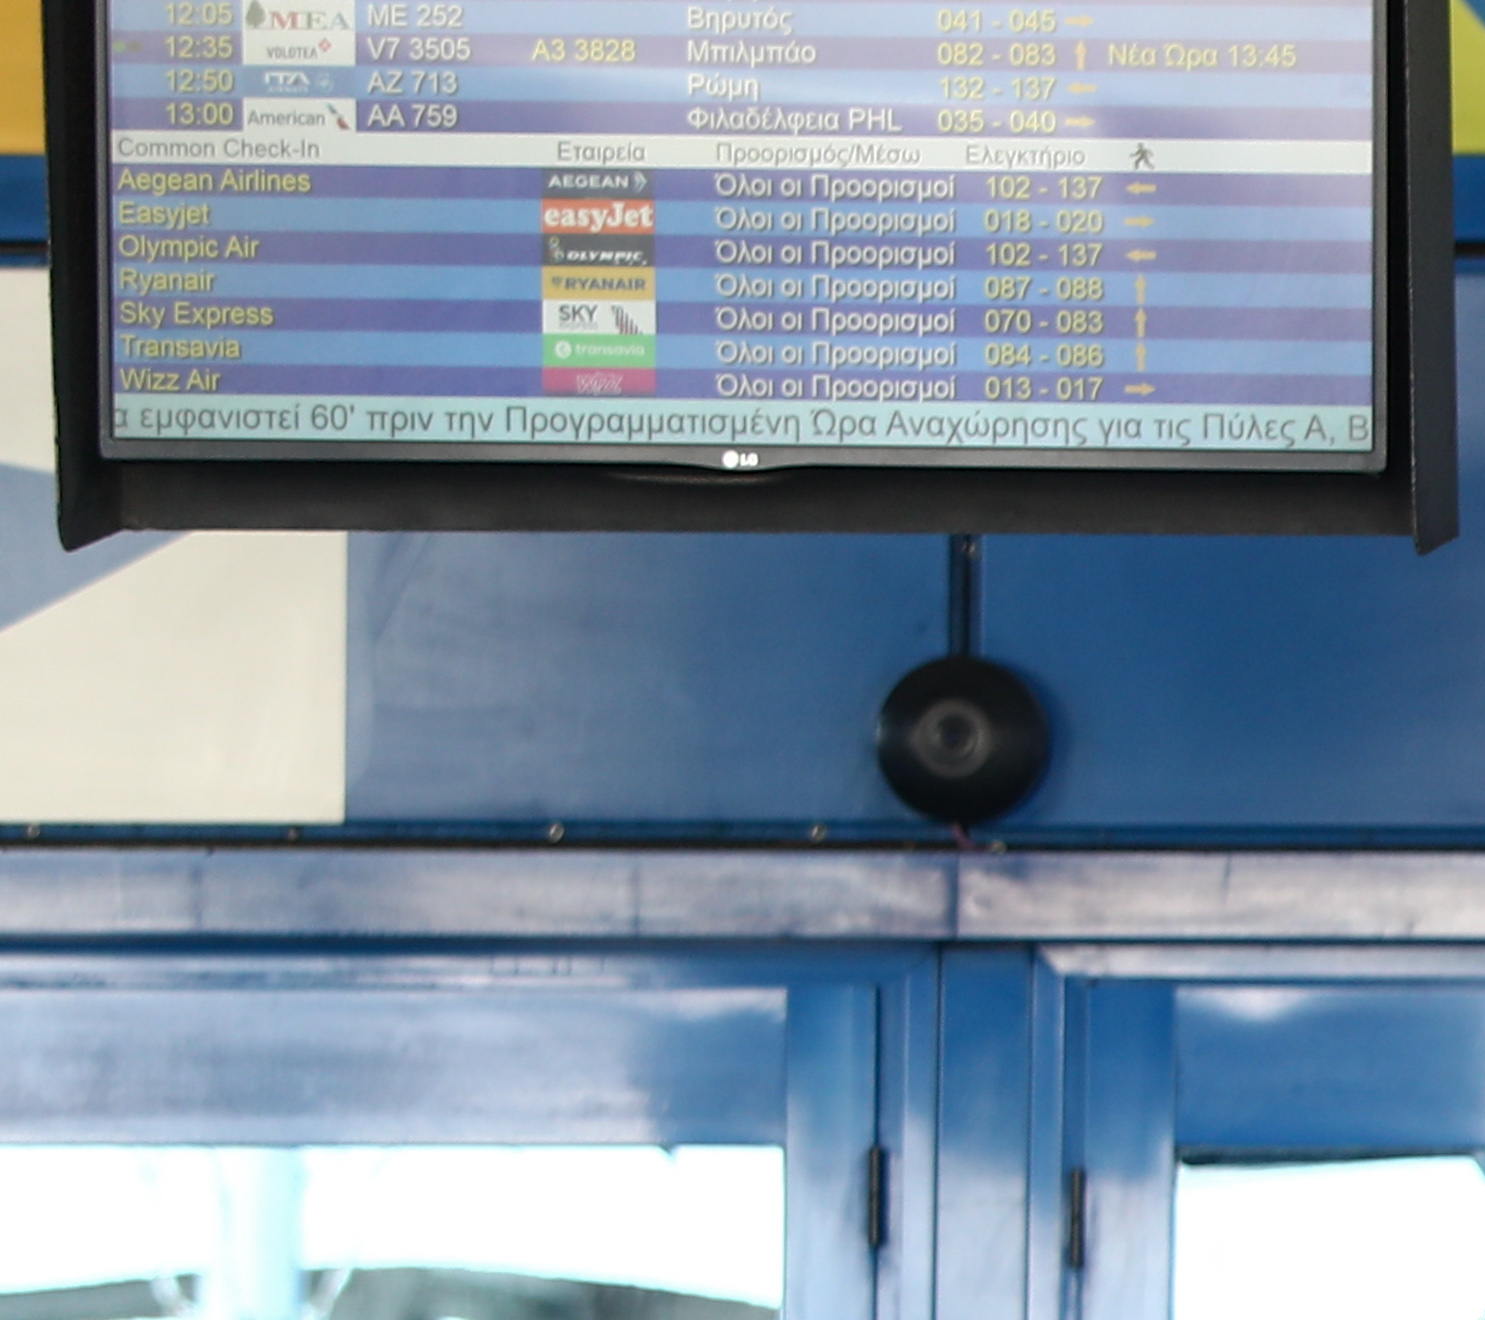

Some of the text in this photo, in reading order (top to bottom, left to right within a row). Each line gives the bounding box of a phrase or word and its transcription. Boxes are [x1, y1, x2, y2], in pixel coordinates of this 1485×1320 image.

[166, 3, 233, 25] 12:05
[270, 11, 350, 30] MEA
[366, 4, 463, 27] ME 252
[687, 6, 793, 34] Βηρυτός
[938, 9, 982, 32] 041
[1009, 9, 1056, 32] 045
[166, 35, 233, 58] 12:35
[266, 46, 318, 59] VOLOTEA
[366, 38, 471, 60] V7 3505
[531, 39, 636, 61] A3 3828
[687, 40, 817, 68] Μπιλμπάο
[938, 43, 982, 66] 082
[1009, 43, 1056, 66] 083
[1109, 43, 1297, 71] Νέα Ώρα 13:45
[166, 69, 234, 92] 12:50
[366, 72, 458, 94] AZ 713
[687, 73, 760, 101] Ρώμη
[939, 77, 984, 99] 132
[1011, 77, 1056, 100] 137
[166, 102, 234, 125] 13:00
[247, 111, 326, 127] American
[366, 105, 459, 128] AA 759
[687, 107, 902, 136] Φιλαδέλφεια PHL
[938, 110, 984, 133] 035
[1010, 110, 1056, 134] 040
[118, 138, 320, 159] Common Check-In
[557, 141, 646, 165] Εταιρεία
[716, 142, 921, 167] Προορισμός/Μέσω
[965, 144, 1086, 170] Ελεγκτήριο
[118, 168, 311, 196] Aegean Airlines
[549, 174, 629, 189] AEGEAN
[714, 173, 956, 203] Όλοι οι Προορισμοί
[986, 175, 1032, 199] 102
[1058, 176, 1104, 200] 137
[118, 201, 210, 230] Easyjet
[544, 202, 654, 233] easyJet
[714, 206, 956, 236] Όλοι οι Προορισμοί
[984, 208, 1032, 232] 018
[1056, 210, 1104, 234] 020
[119, 234, 260, 263] Olympic Air
[567, 251, 644, 265] OLYMPIC
[714, 240, 956, 270] Όλοι οι Προορισμοί
[986, 242, 1032, 266] 102
[1058, 243, 1104, 267] 137
[118, 267, 215, 296] Ryanair
[566, 278, 646, 290] RYANAIR
[714, 274, 956, 304] Όλοι οι Προορισμοί
[984, 276, 1032, 300] 087
[1056, 276, 1104, 300] 088
[120, 301, 274, 329] Sky Express
[558, 304, 598, 322] SKY
[714, 307, 956, 337] Όλοι οι Προορισμοί
[984, 309, 1032, 333] 070
[1056, 310, 1104, 334] 083
[120, 333, 241, 358] Transavia
[576, 344, 645, 355] transavia
[714, 340, 956, 370] Όλοι οι Προορισμοί
[984, 342, 1032, 366] 084
[1056, 343, 1104, 367] 086
[120, 367, 221, 391] Wizz Air
[714, 374, 956, 404] Όλοι οι Προορισμοί
[984, 376, 1032, 400] 013
[1056, 376, 1104, 400] 017
[140, 404, 300, 439] εμφανιστεί
[311, 404, 355, 431] 60'
[367, 410, 432, 439] πριν
[445, 410, 494, 439] την
[505, 405, 801, 442] Προγραμματισμένη
[809, 407, 878, 443] Ώρα
[886, 411, 1088, 446] Αναχώρησης
[1099, 420, 1142, 446] για
[1154, 420, 1191, 446] τις
[1203, 412, 1296, 447] Πύλες
